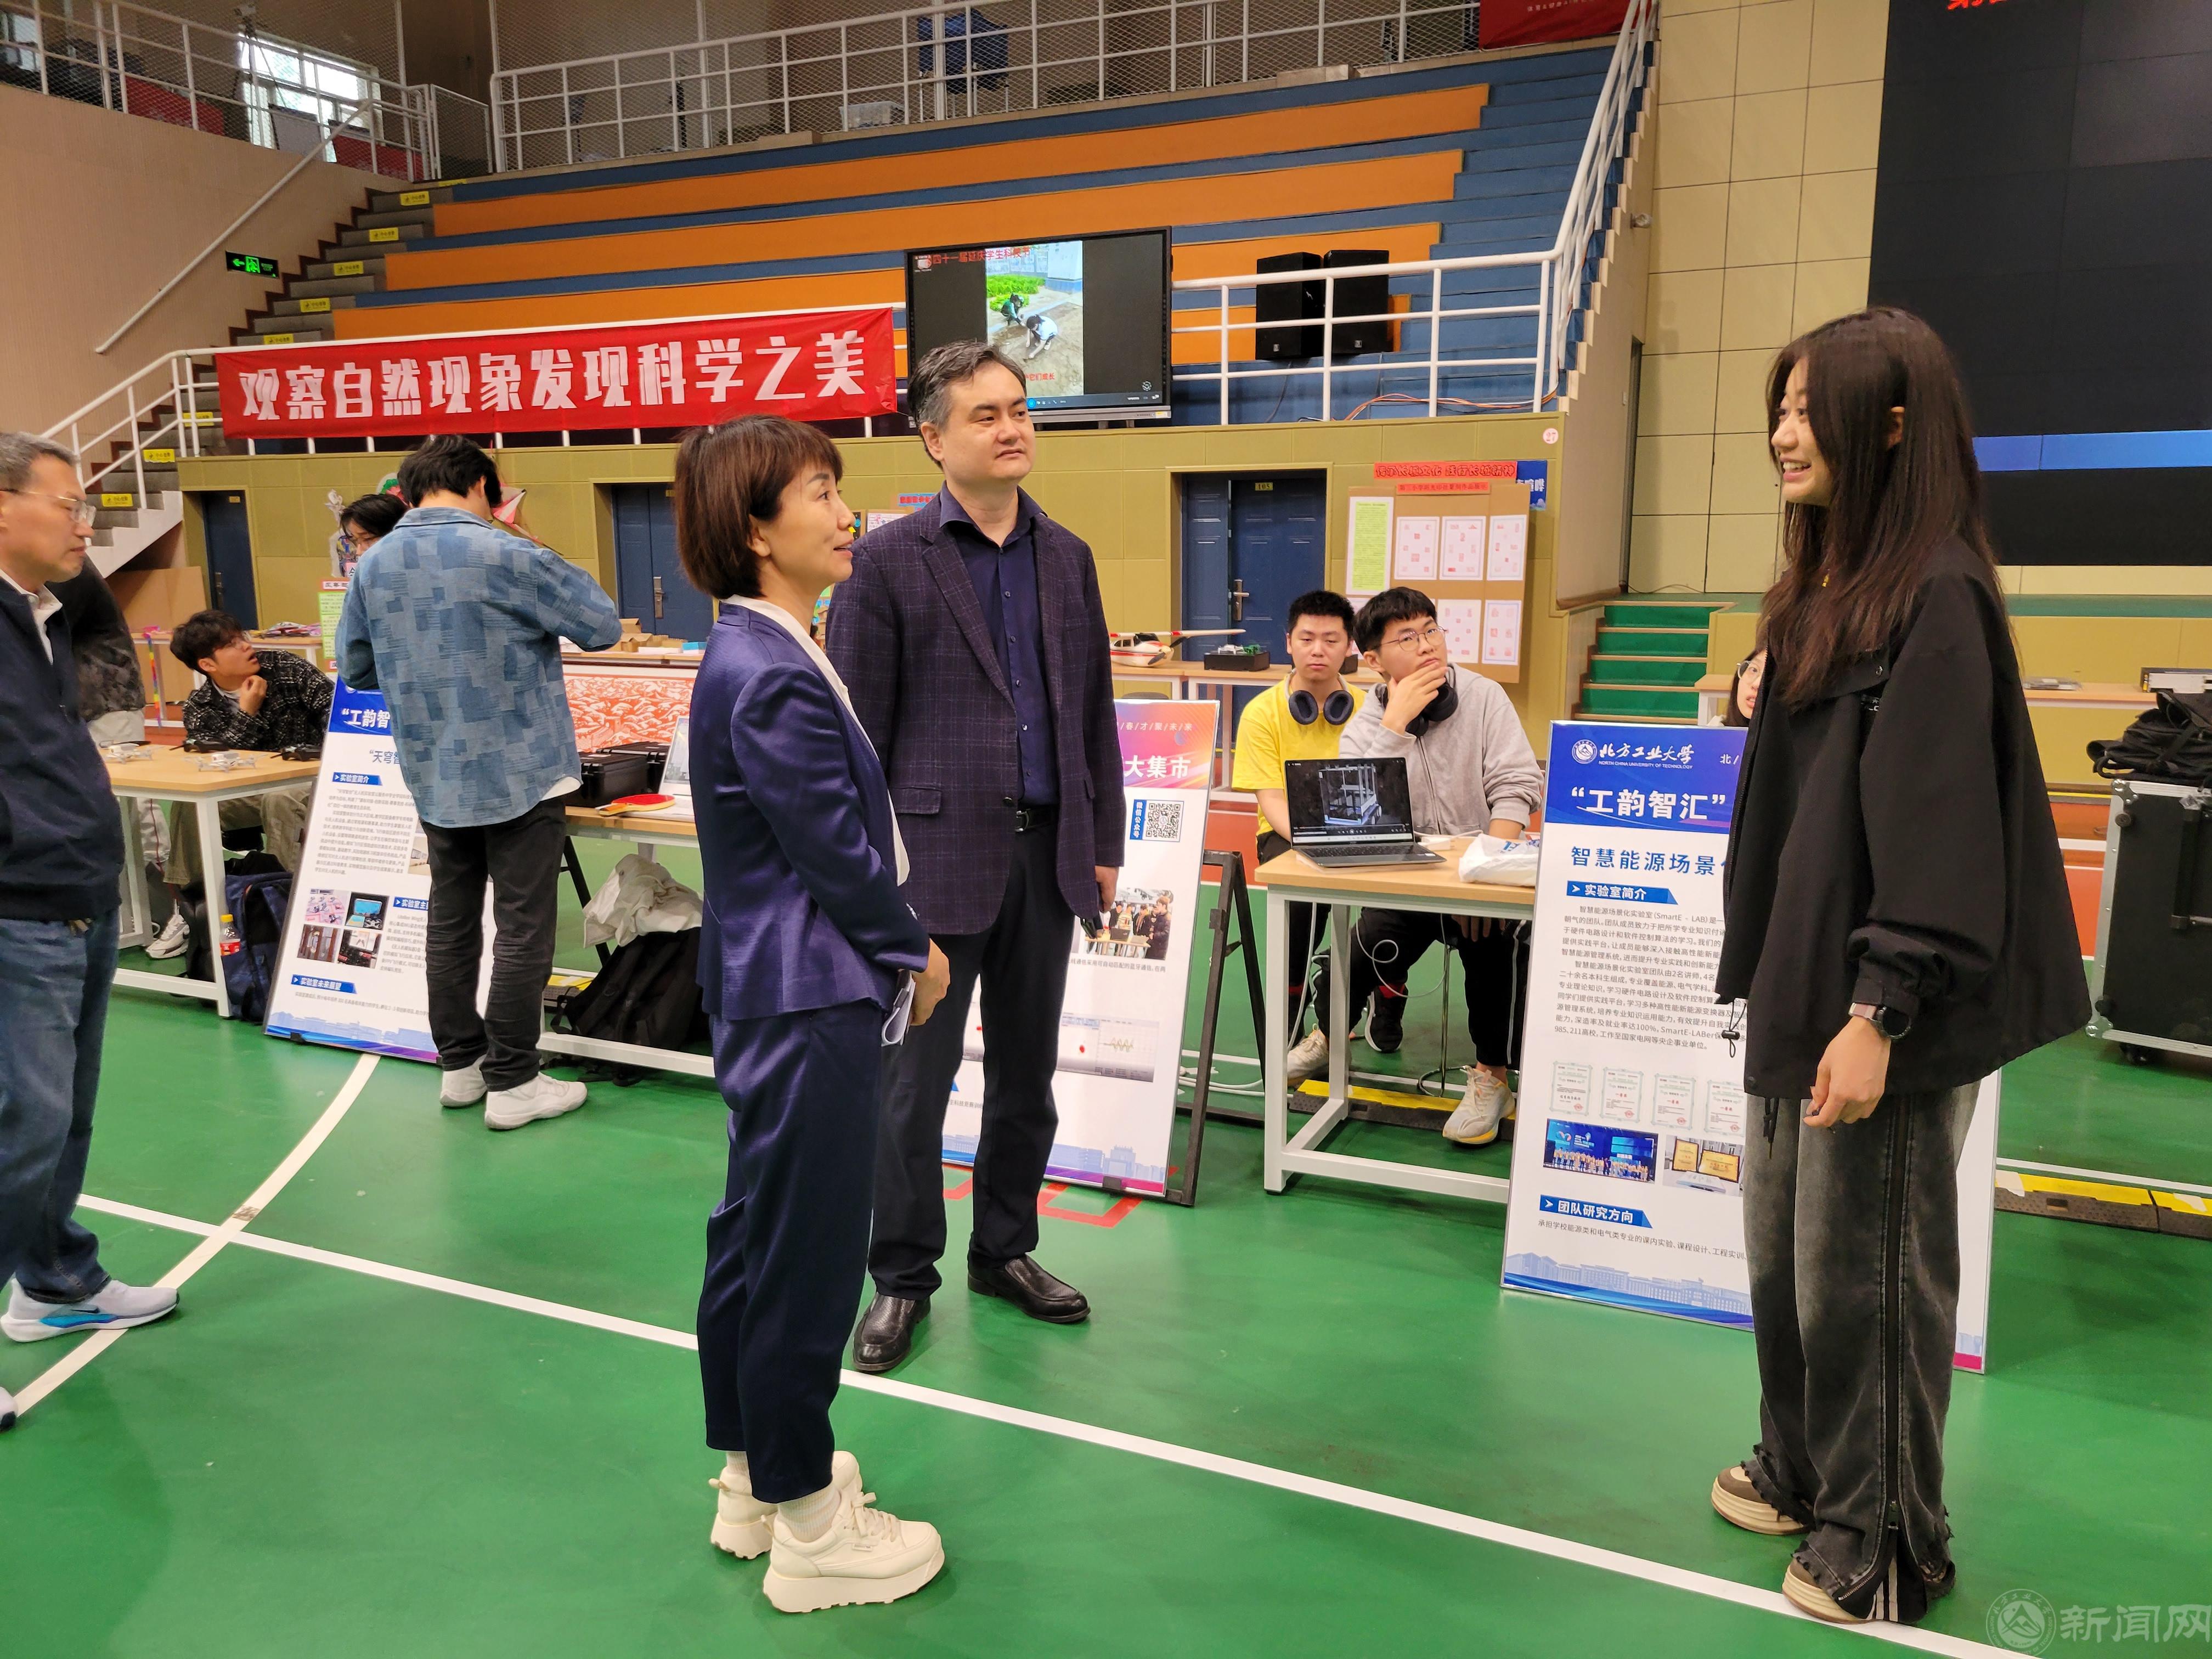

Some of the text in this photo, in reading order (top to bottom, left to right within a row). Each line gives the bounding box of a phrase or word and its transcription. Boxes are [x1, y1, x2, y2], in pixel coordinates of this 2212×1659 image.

[239, 330, 866, 421] 观察自然现象发现科学之美
[1599, 742, 1695, 765] 北方工业大学
[1124, 754, 1192, 778] 大集市
[1571, 786, 1726, 820] “工韵智汇”
[1571, 845, 1726, 876] 智慧能源场景
[1584, 884, 1647, 901] 实验室简介
[1558, 1200, 1633, 1224] 团队研究方向
